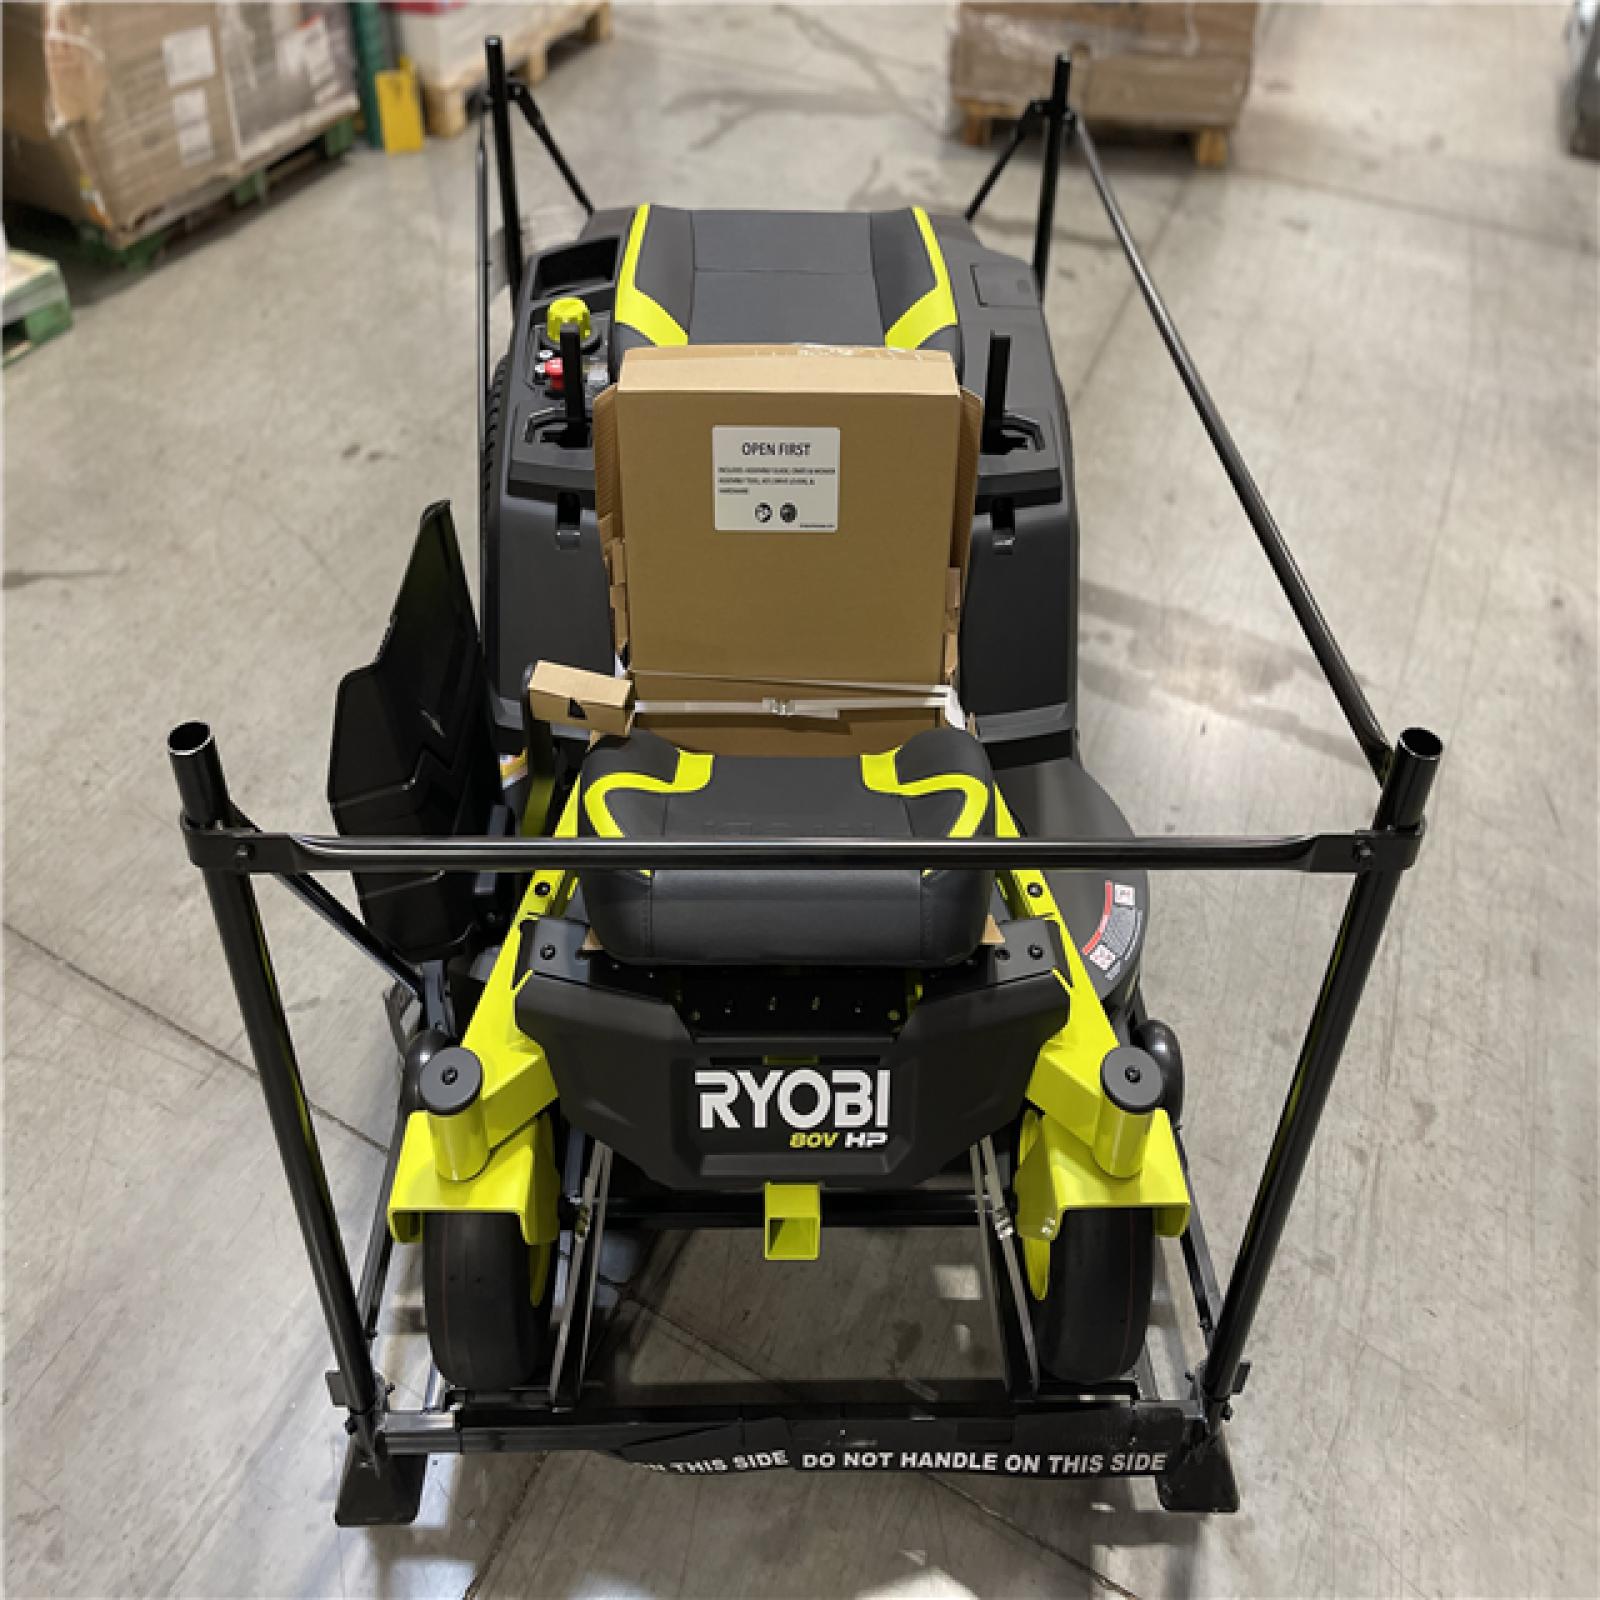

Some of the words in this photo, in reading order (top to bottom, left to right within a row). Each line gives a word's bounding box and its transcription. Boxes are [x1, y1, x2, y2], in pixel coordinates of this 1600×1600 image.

[742, 441, 776, 456] OPEN
[779, 441, 811, 457] FIRST
[695, 1069, 891, 1129] RYOBI
[789, 1132, 839, 1148] 80V
[845, 1132, 889, 1148] HP
[802, 1452, 836, 1469] DO
[844, 1451, 894, 1469] NOT
[900, 1451, 999, 1471] HANDLE
[1004, 1454, 1041, 1474] ON
[1047, 1454, 1105, 1474] THIS
[1109, 1452, 1169, 1473] SIDE
